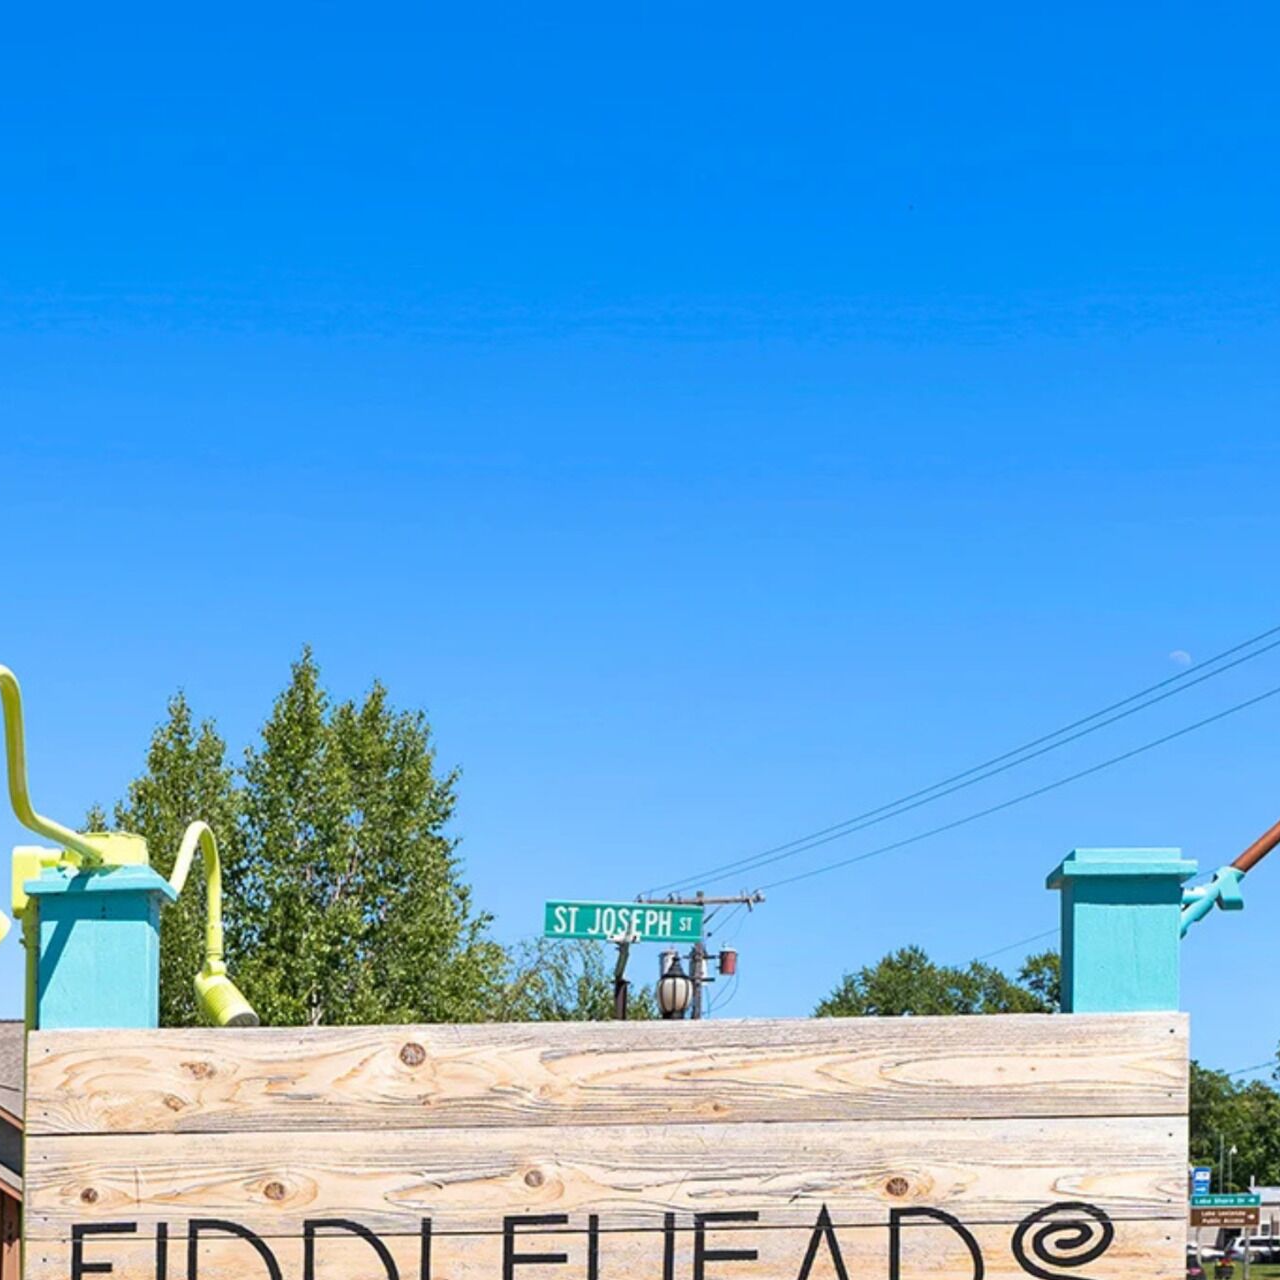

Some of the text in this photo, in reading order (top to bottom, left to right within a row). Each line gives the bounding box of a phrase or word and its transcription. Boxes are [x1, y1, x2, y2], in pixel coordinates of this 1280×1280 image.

[553, 906, 694, 937] ST JOSEPH ST
